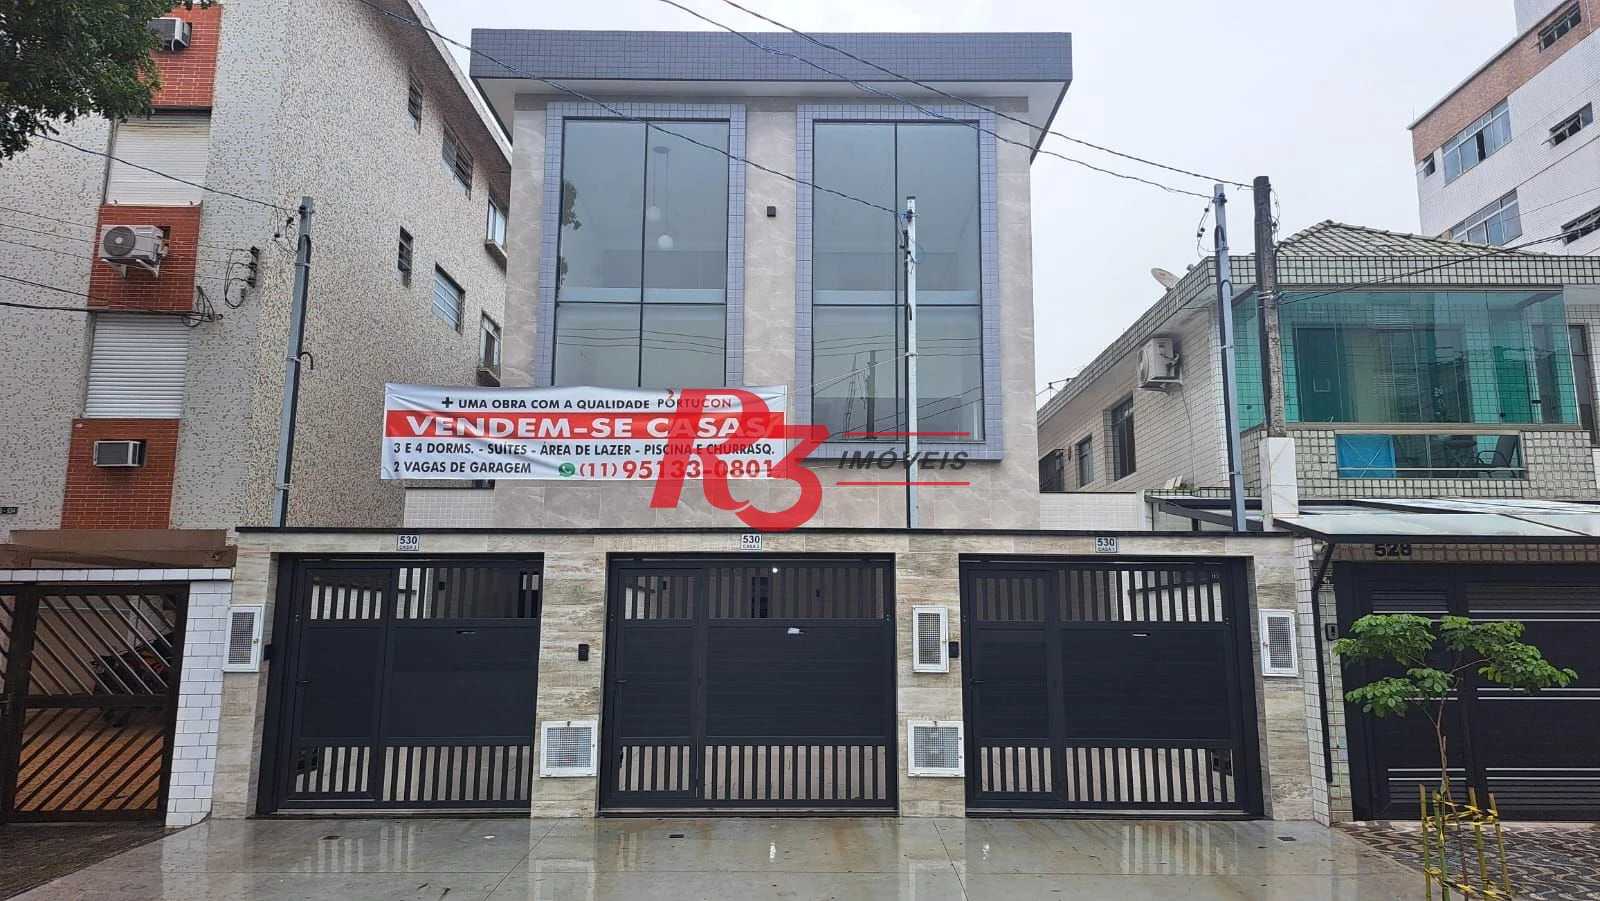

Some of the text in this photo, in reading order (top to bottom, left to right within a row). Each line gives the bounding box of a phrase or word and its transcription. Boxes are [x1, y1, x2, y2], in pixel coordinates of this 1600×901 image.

[459, 399, 488, 409] UMA
[492, 399, 526, 409] OBRA
[531, 400, 560, 409] COM
[563, 400, 573, 409] A
[577, 399, 650, 410] QUALIDADE
[657, 398, 732, 409] PORTUCON
[406, 415, 633, 439] VENDEM-SE
[393, 442, 400, 453] 3
[405, 443, 411, 453] E
[415, 443, 422, 453] 4
[427, 442, 474, 454] DORMS.
[487, 441, 527, 455] SUÍTES
[540, 441, 571, 456] ÁREA
[575, 444, 591, 456] DE
[594, 444, 631, 456] LAZER
[644, 444, 692, 456] PISCINA
[696, 444, 703, 455] E
[706, 443, 775, 456] CHURRASQ.
[393, 461, 532, 473] 2 VAGAS DE GARAGEM
[580, 462, 618, 478] (11)
[400, 535, 418, 545] 530
[742, 535, 760, 544] 530
[1097, 538, 1115, 547] 530
[1375, 543, 1412, 557] 528
